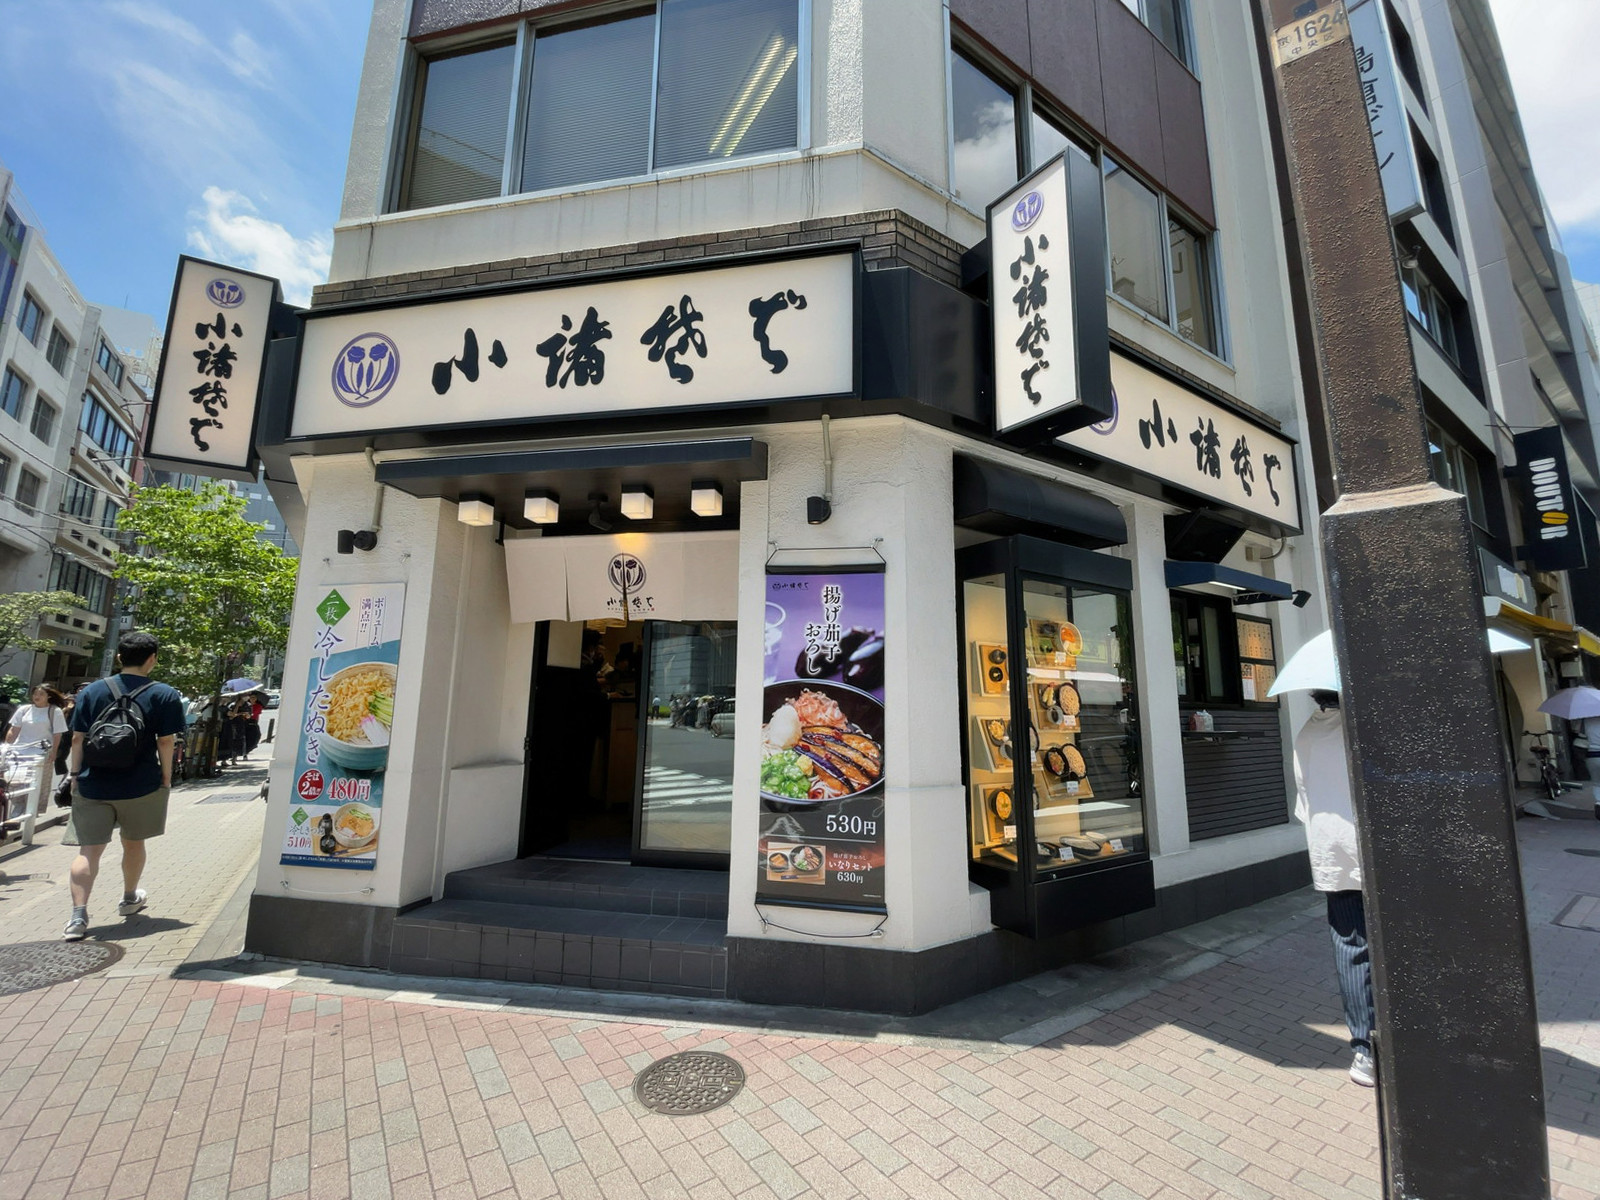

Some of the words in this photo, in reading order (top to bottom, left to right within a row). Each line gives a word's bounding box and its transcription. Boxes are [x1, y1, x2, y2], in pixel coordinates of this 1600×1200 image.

[1293, 10, 1344, 43] 1624
[1291, 32, 1335, 54] 中央区
[1529, 457, 1570, 540] DOUTOR
[325, 594, 340, 621] 二枚
[371, 597, 385, 646] ボリューム
[823, 586, 842, 661] 揚げ茄子
[805, 623, 822, 674] おろし
[305, 626, 344, 763] 冷したぬき
[305, 772, 320, 781] そば
[328, 778, 371, 801] 480円
[826, 814, 877, 835] 530円
[287, 836, 312, 849] 510円
[828, 860, 873, 872] いなりセット
[837, 871, 864, 884] 630円
